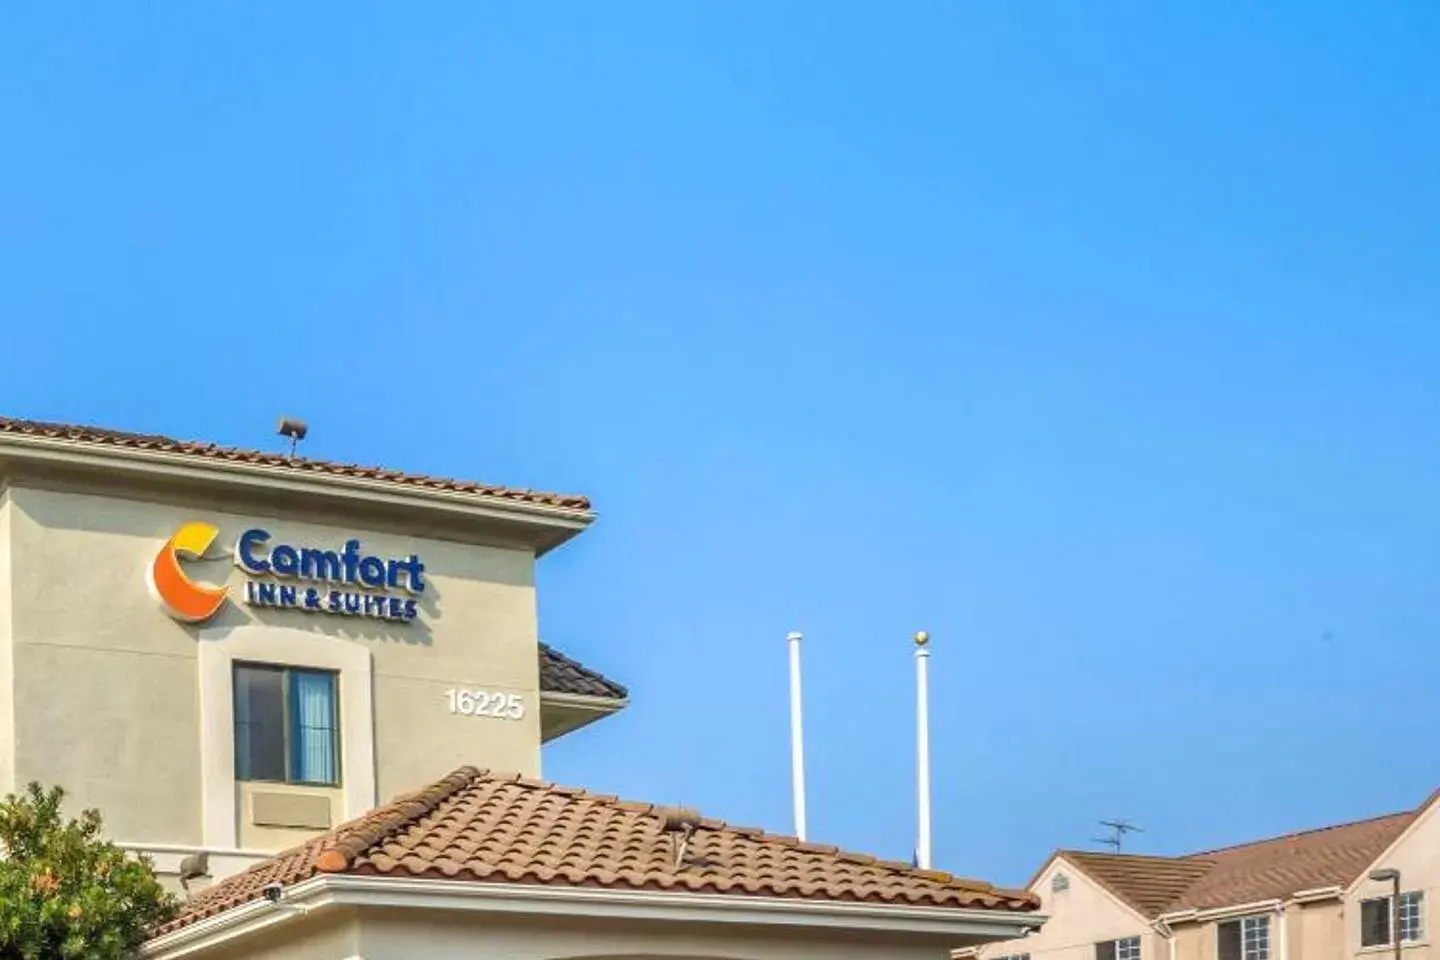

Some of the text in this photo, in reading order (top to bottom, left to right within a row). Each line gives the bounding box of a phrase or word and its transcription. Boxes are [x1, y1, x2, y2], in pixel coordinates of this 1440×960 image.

[237, 528, 426, 593] Comfort
[245, 581, 418, 620] INN & SUITES
[444, 688, 525, 719] 16225
